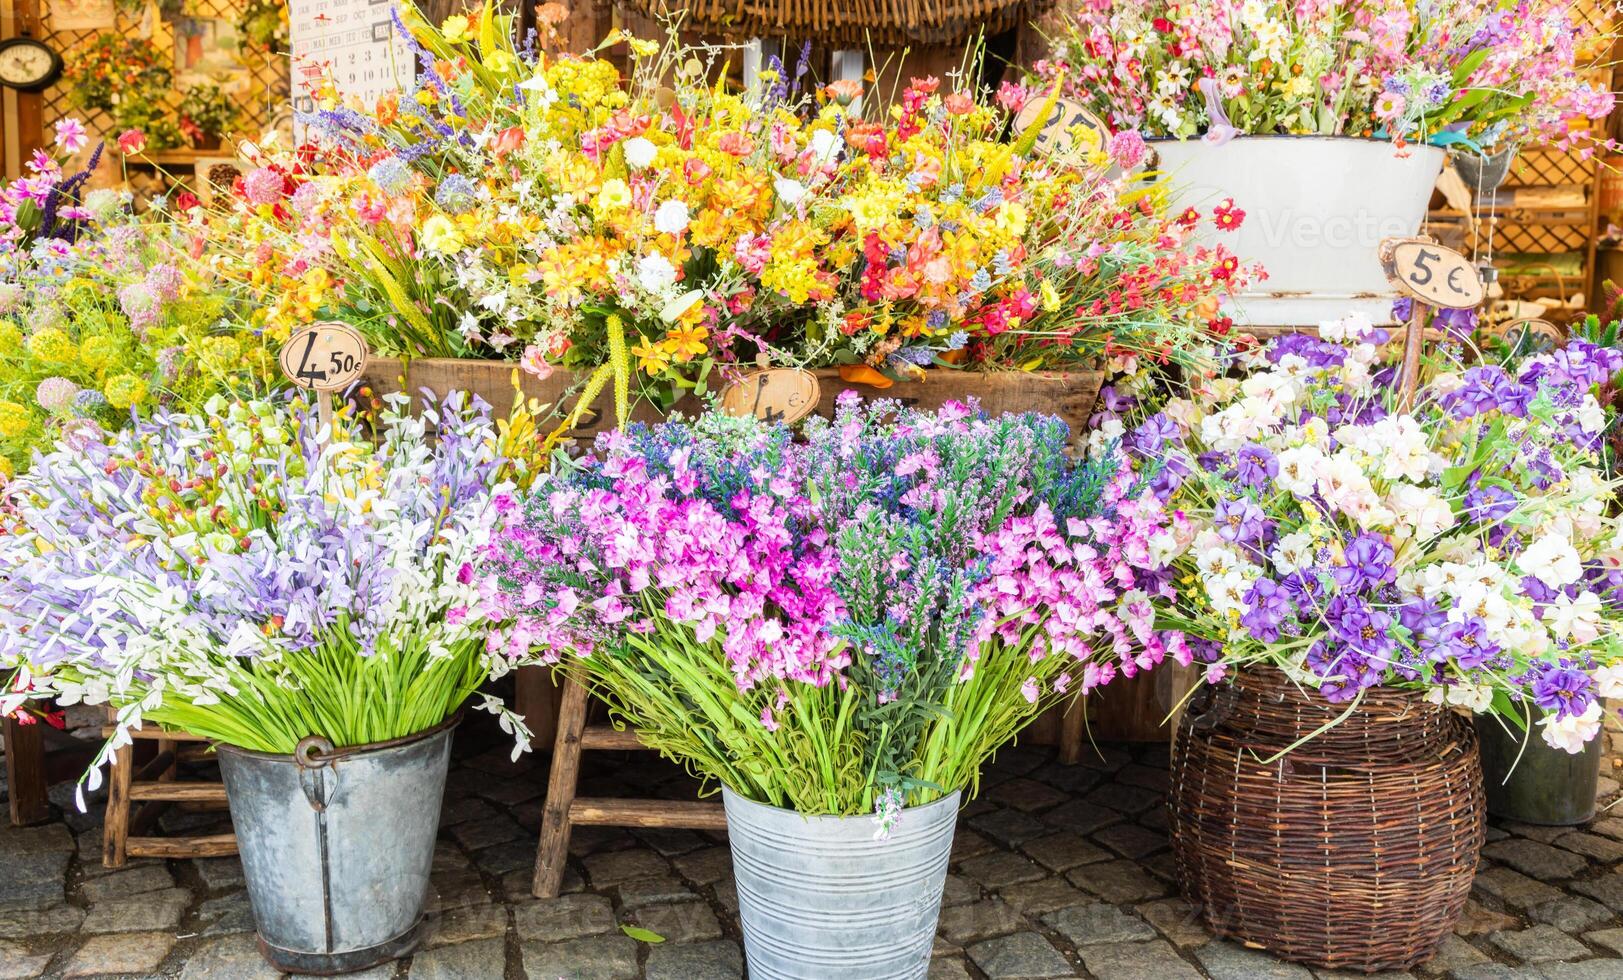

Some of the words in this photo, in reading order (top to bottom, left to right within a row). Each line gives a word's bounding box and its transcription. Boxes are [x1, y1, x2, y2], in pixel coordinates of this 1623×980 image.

[348, 53, 355, 65] 2
[364, 50, 372, 61] 3
[349, 72, 356, 84] 9
[363, 70, 374, 82] 10
[380, 66, 390, 79] 11
